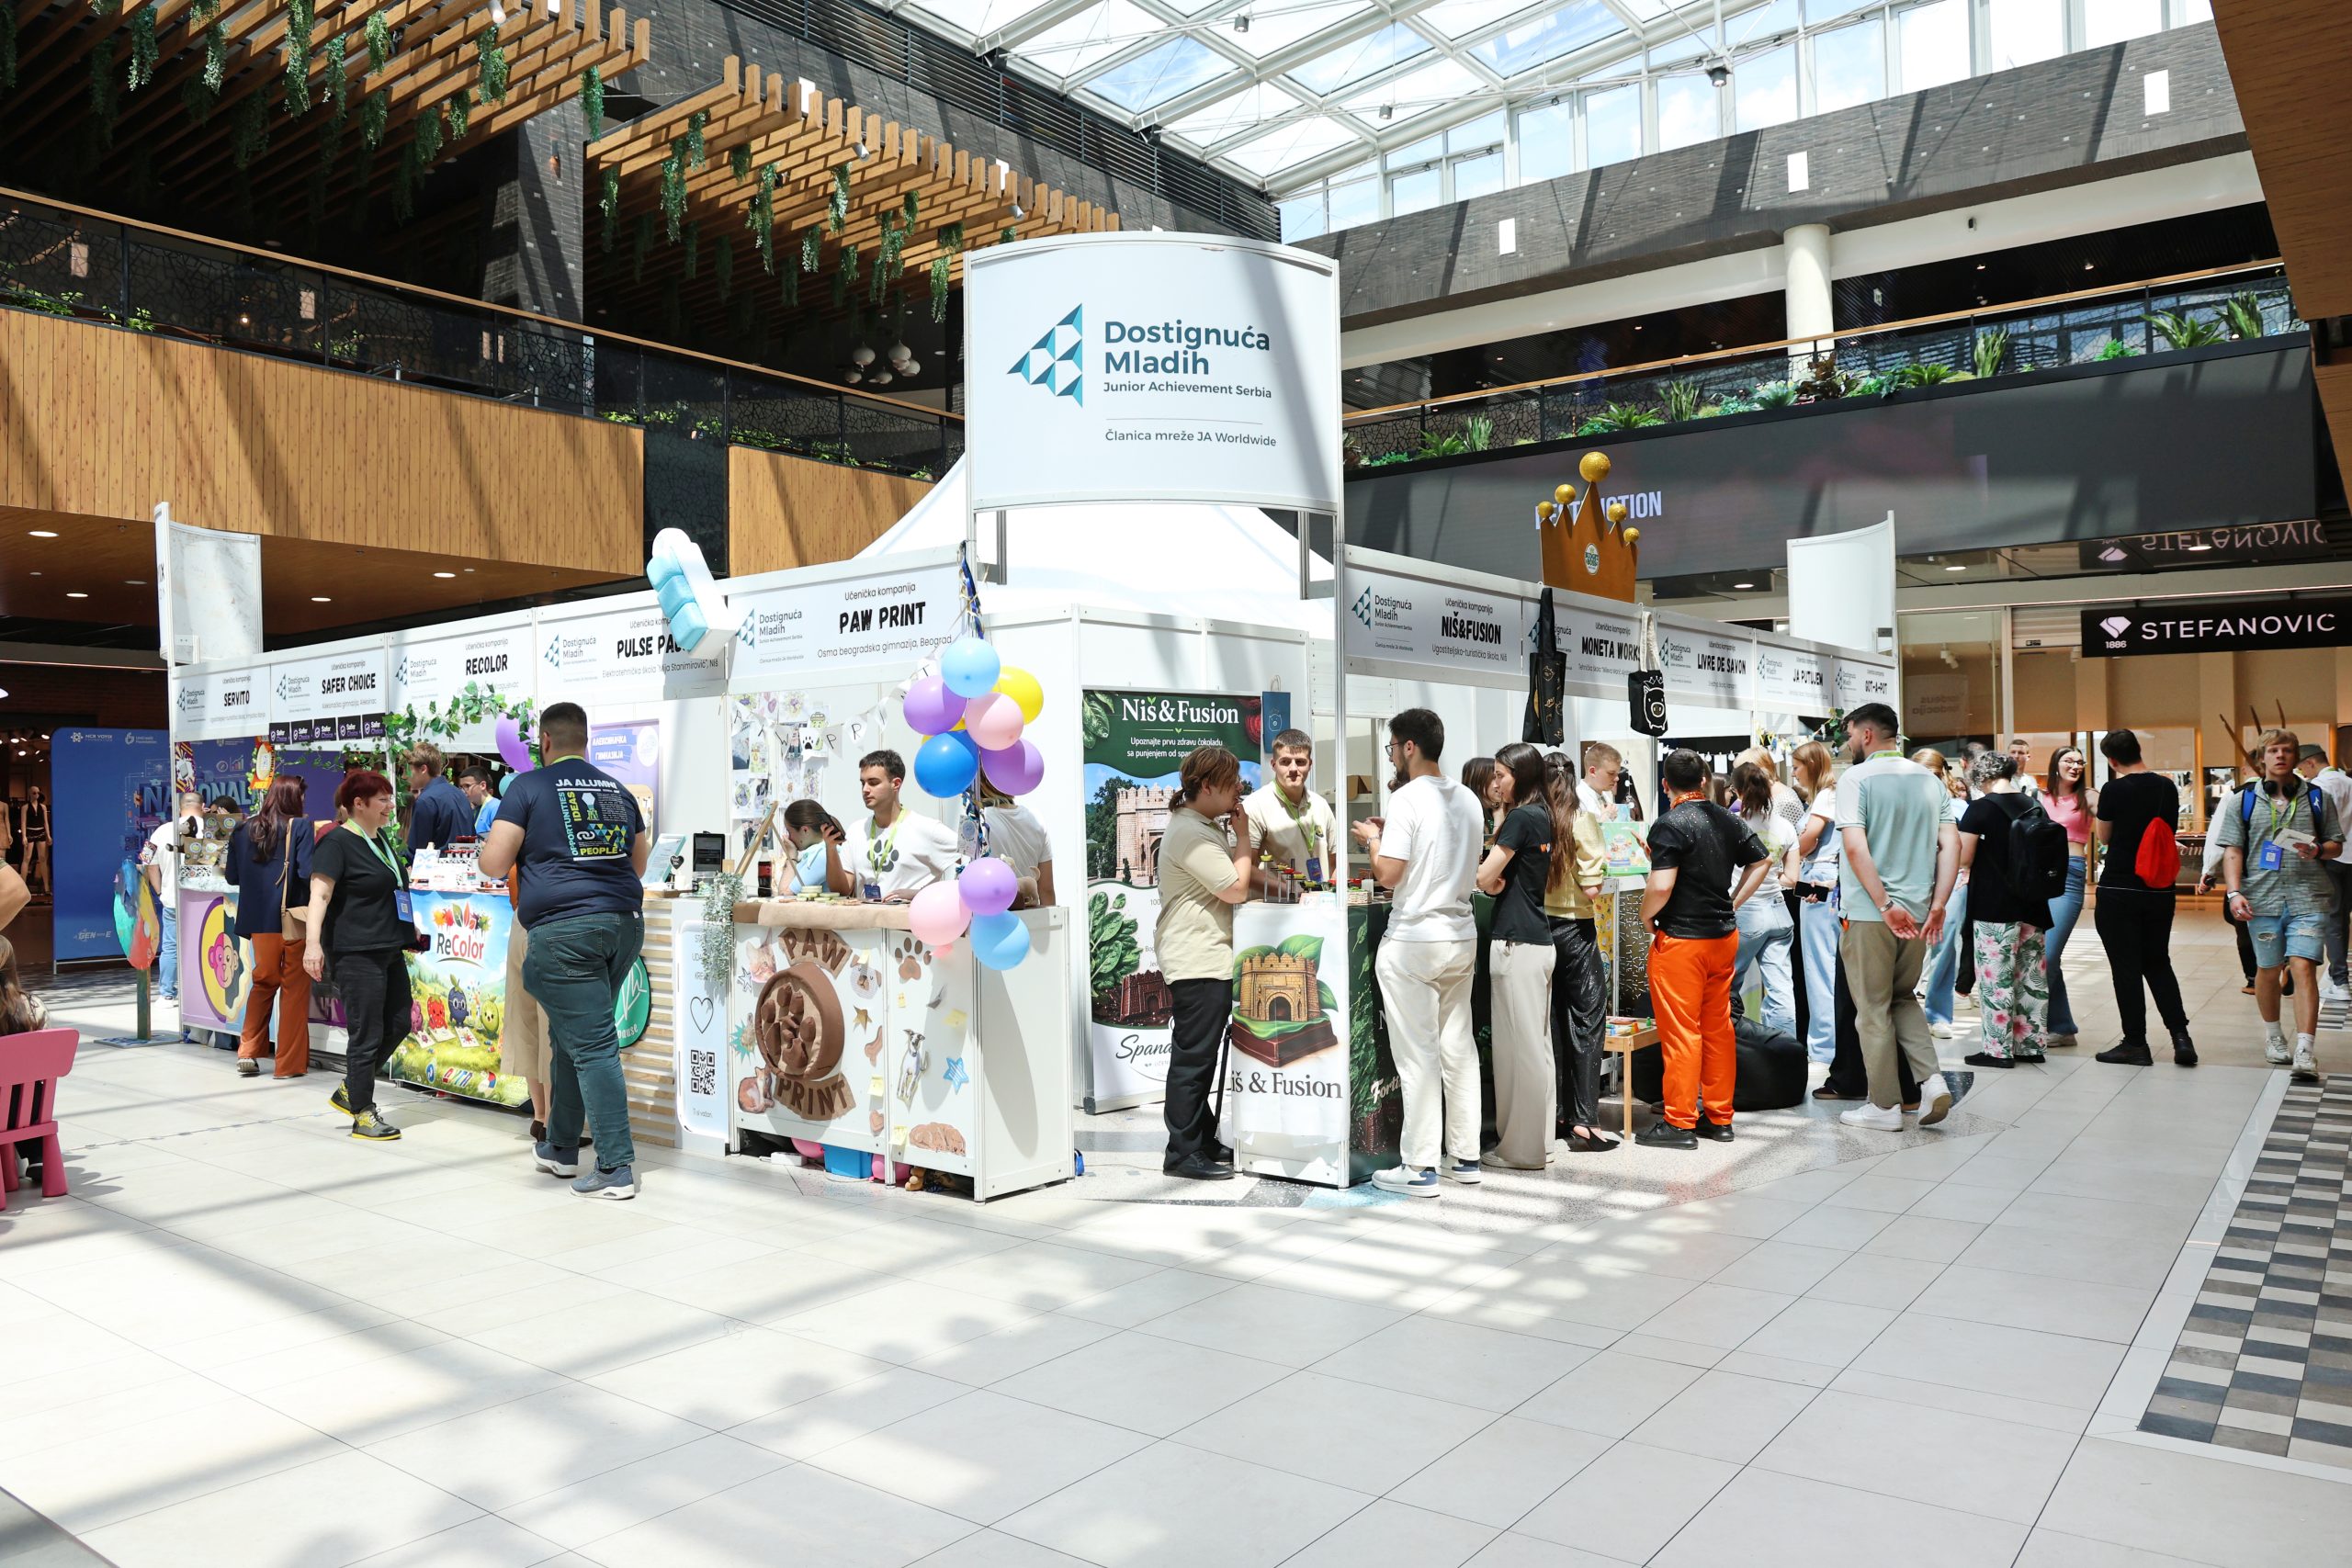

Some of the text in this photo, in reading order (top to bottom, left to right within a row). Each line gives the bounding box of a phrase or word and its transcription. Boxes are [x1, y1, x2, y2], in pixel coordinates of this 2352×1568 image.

[1104, 319, 1271, 351] Dostignuća
[1104, 351, 1210, 376] Mladih
[1103, 380, 1272, 399] Junior Achievement Serbia
[1105, 429, 1277, 446] Članica mreže JA Worldwide
[844, 583, 916, 601] Učenička kompanija
[1374, 594, 1412, 611] Dostignuća
[1444, 597, 1494, 615] Učenička kompanija
[759, 608, 803, 624] Dostignuća
[839, 601, 926, 634] PAW PRINT
[1374, 608, 1398, 622] Mladih
[759, 624, 786, 637] Mladih
[1442, 612, 1501, 645] NIŠ&FUSION
[2141, 613, 2336, 640] STEFANOVIC
[562, 636, 596, 649] Dostignuća
[616, 636, 653, 659] PULSE
[818, 635, 952, 659] Osma beogradska gimnazija, Beograd
[1581, 637, 1615, 659] MONETA
[2105, 640, 2128, 649] 1886
[562, 649, 583, 659] Mladih
[709, 658, 718, 668] Niš
[1499, 653, 1508, 662] Niš
[466, 653, 508, 675] RECOLOR
[1697, 653, 1747, 675] LIVRE DE SAVON
[322, 672, 376, 694] SAFER CHOICE
[1792, 669, 1801, 683] JA
[223, 690, 250, 706] SERVITO
[1177, 700, 1240, 724] Fusion
[1130, 737, 1223, 747] Upoznajte prvu zdravu čokoladu
[1136, 749, 1168, 759] punjenjem
[1168, 749, 1177, 757] od
[556, 779, 617, 790] JA ALUMNI
[567, 791, 582, 822] IDEAS
[559, 792, 579, 856] OPPORTUNITIES
[580, 846, 618, 855] PEOPLE
[436, 932, 484, 960] ReColor
[784, 929, 847, 971] PAW
[1231, 1070, 1343, 1099] iš & Fusion
[777, 1078, 848, 1115] PRINT
